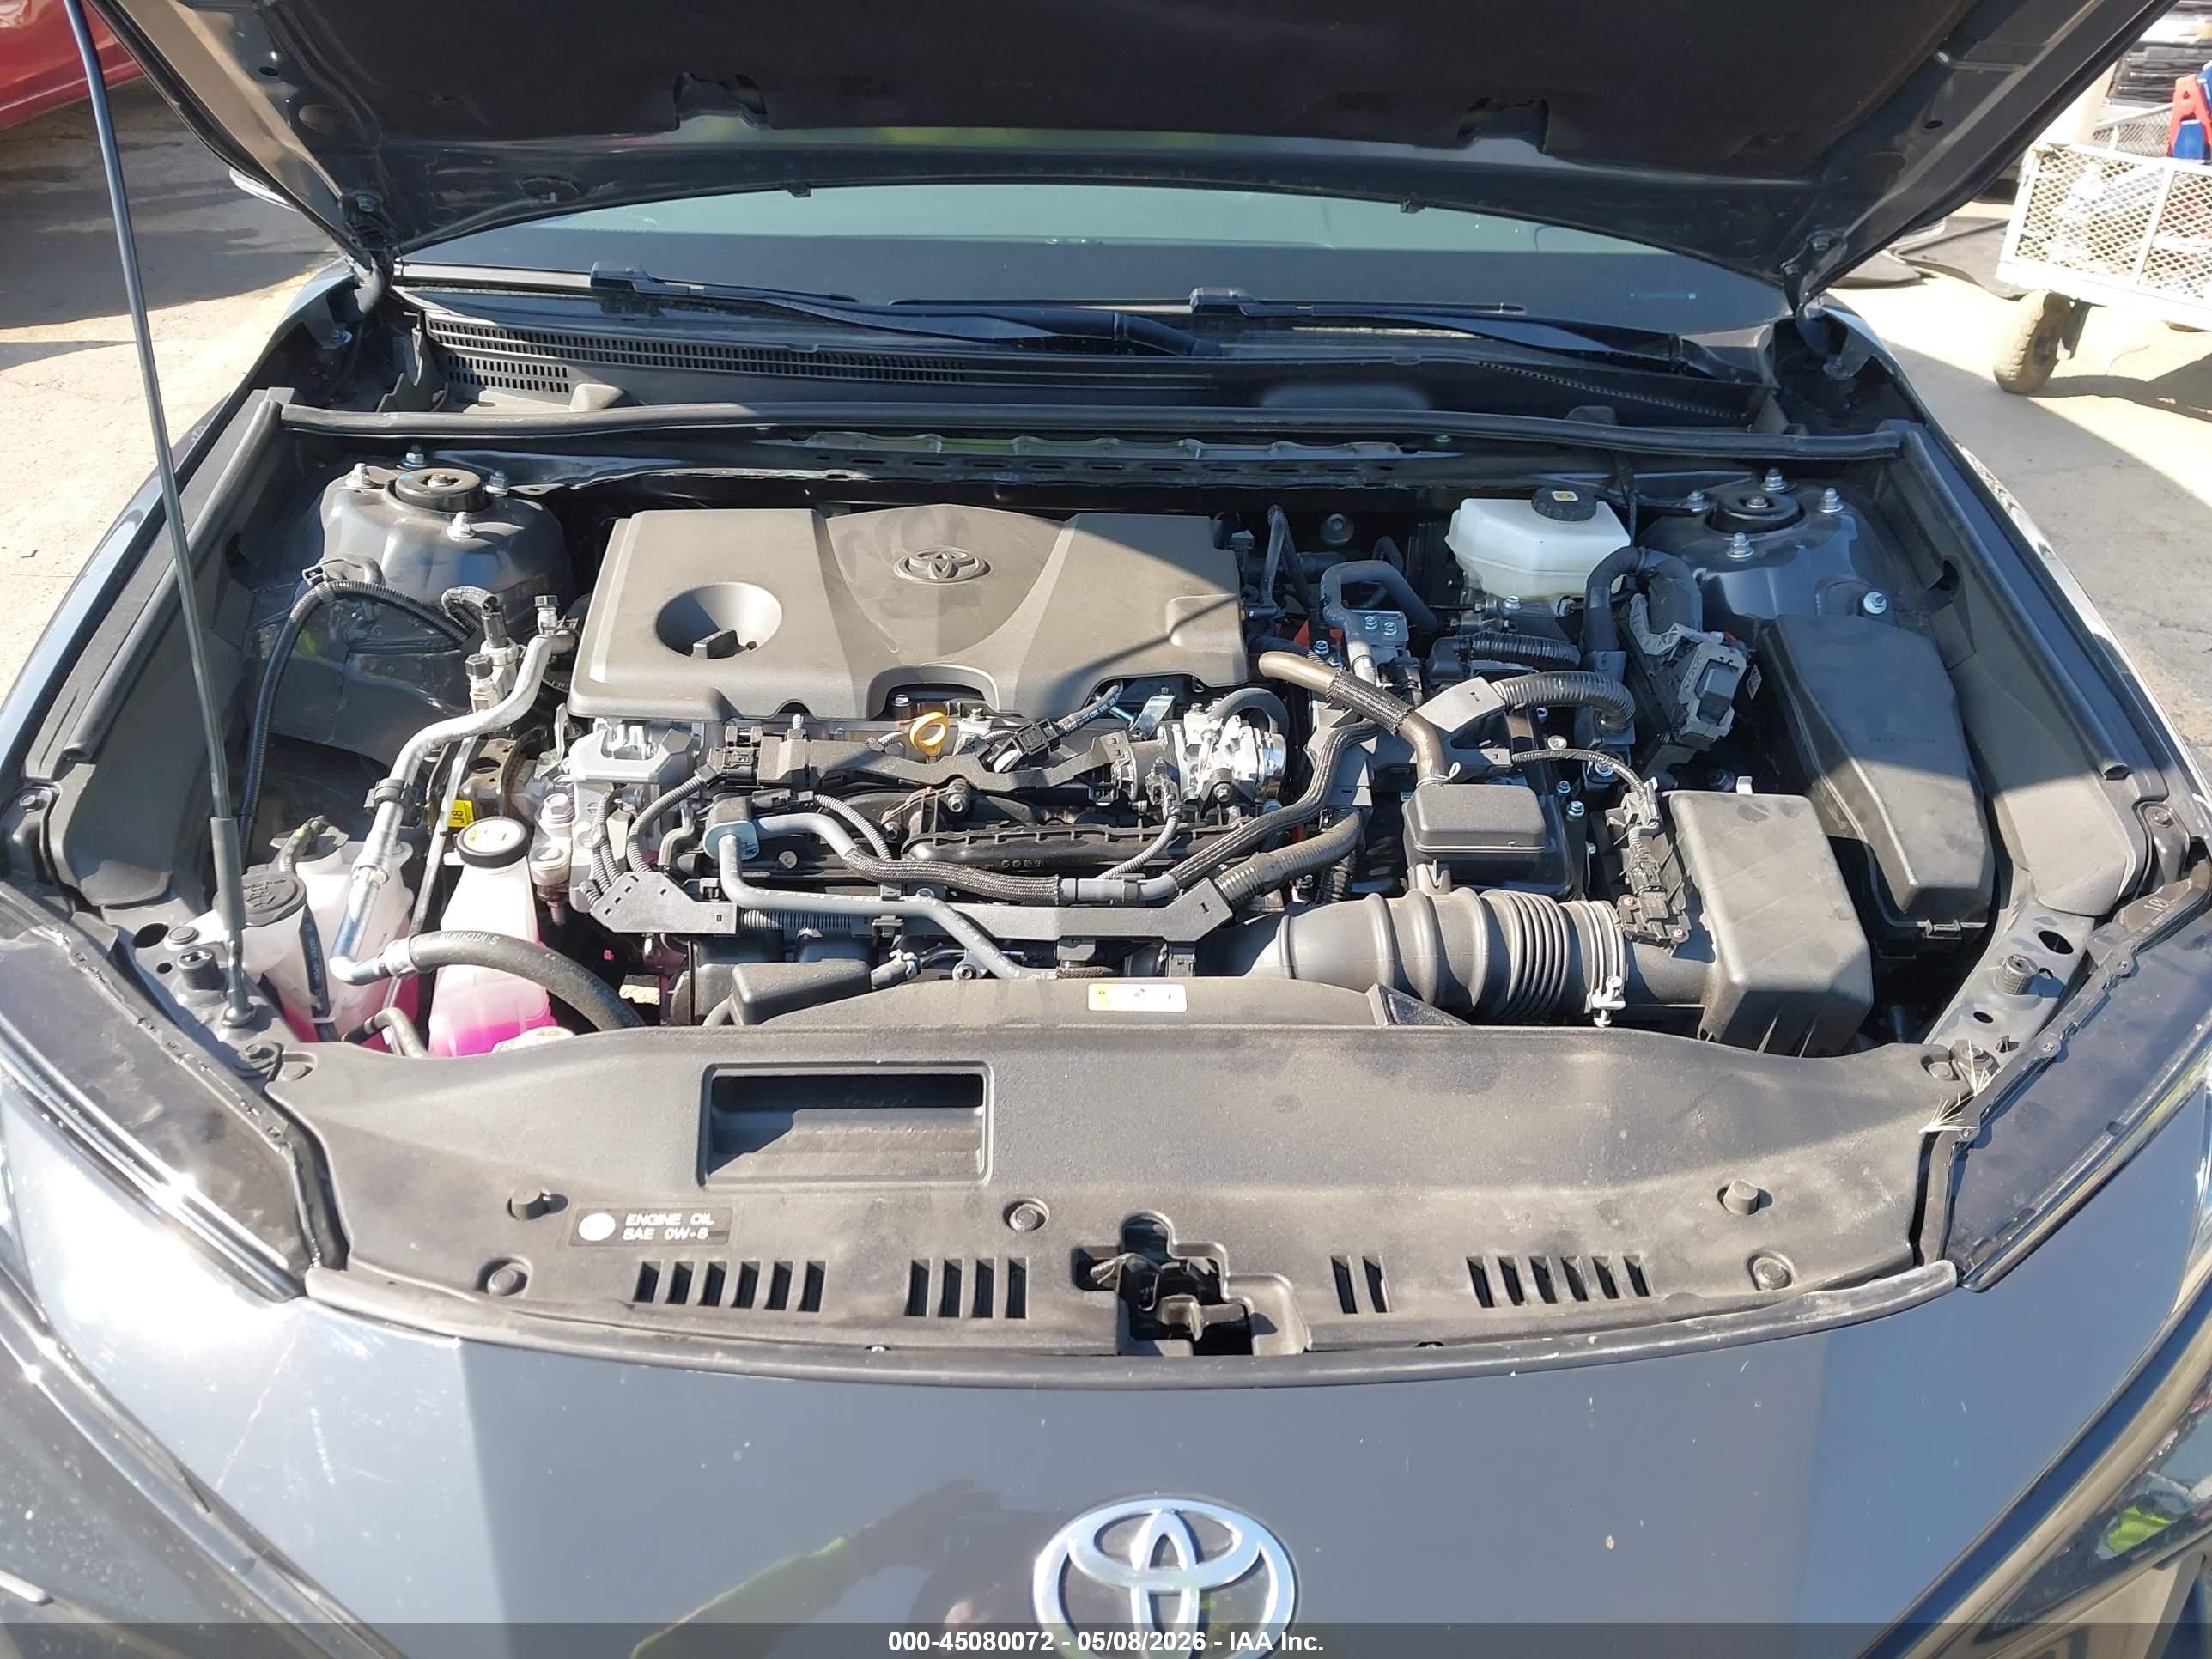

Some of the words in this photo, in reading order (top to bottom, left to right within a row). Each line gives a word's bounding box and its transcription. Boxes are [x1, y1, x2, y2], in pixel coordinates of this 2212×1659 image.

[625, 1212, 682, 1226] ENGINE
[690, 1212, 715, 1225] OIL
[622, 1227, 655, 1240] SAE
